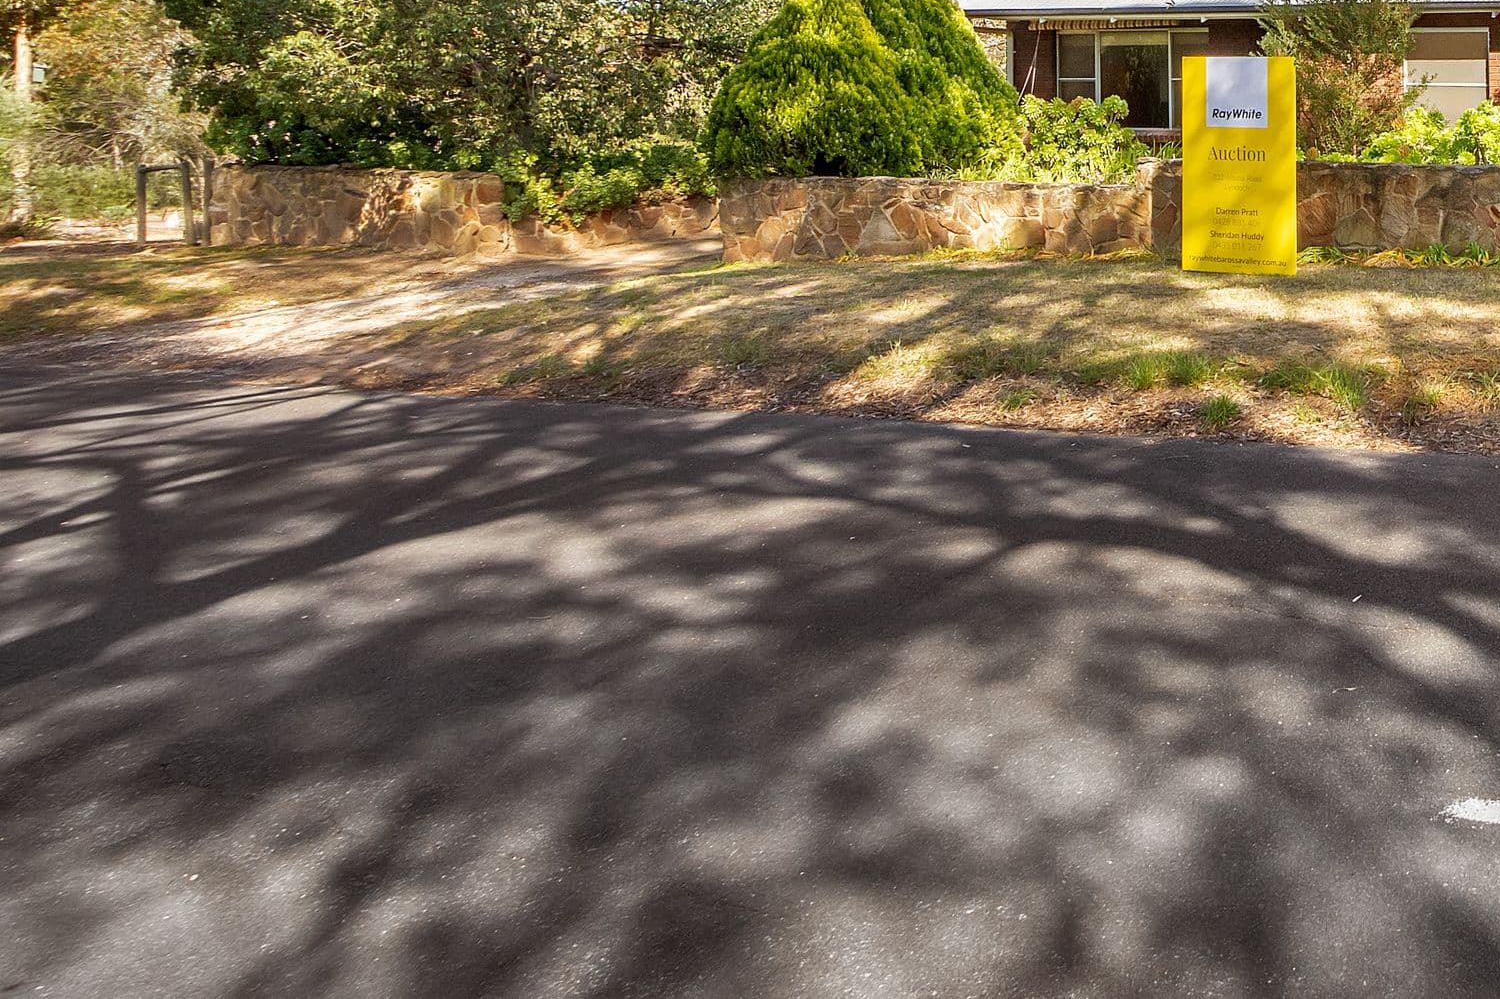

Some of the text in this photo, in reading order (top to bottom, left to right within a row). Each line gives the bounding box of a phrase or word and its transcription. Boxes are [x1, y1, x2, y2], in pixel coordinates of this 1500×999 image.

[1208, 146, 1266, 162] Auction
[1216, 207, 1258, 217] Darren Pratt
[1210, 230, 1264, 242] Sheridan Huddy
[1189, 254, 1287, 267] raywhitebarossavalley.com.au
